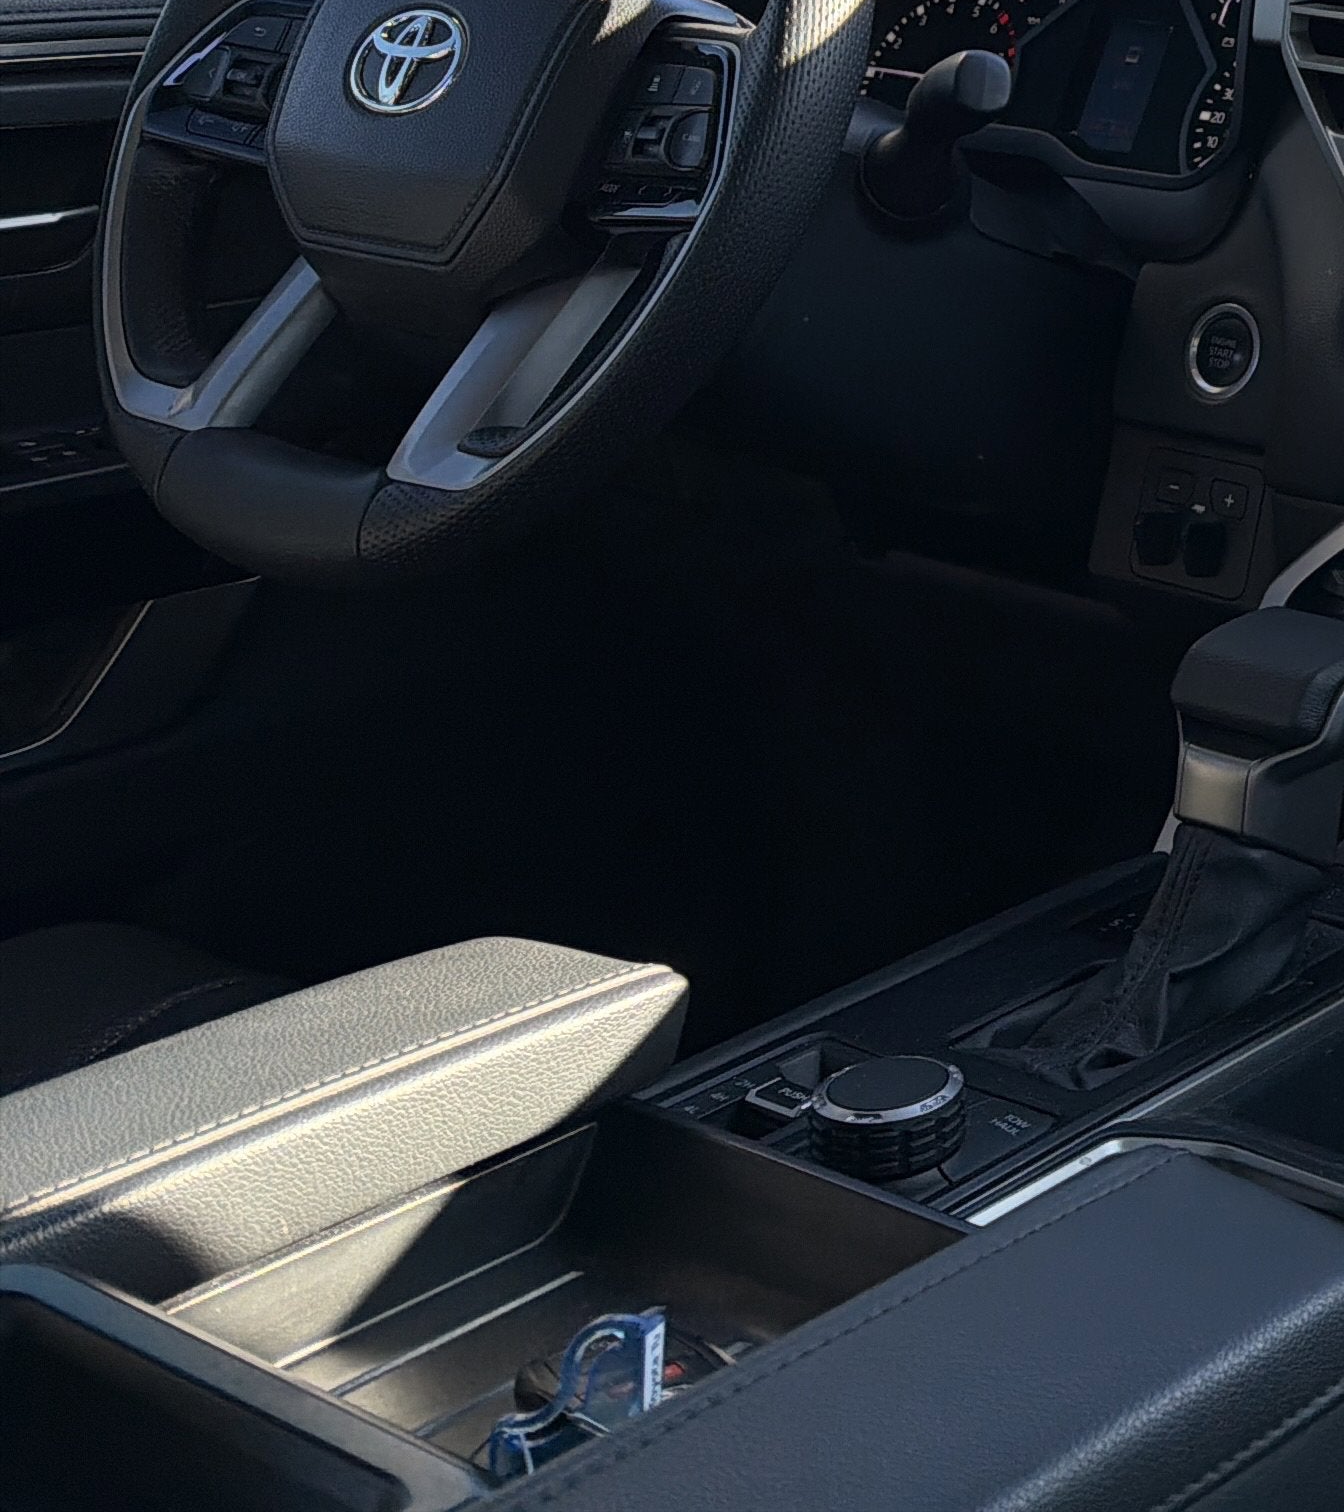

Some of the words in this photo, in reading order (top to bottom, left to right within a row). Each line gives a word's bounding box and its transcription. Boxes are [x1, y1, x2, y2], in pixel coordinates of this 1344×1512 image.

[1210, 111, 1226, 125] 20
[1206, 136, 1218, 149] 10
[1210, 346, 1235, 359] START
[1208, 357, 1231, 369] STOP
[778, 1087, 808, 1102] PUSH
[991, 1117, 1022, 1137] HAUL
[1003, 1113, 1032, 1129] TOW
